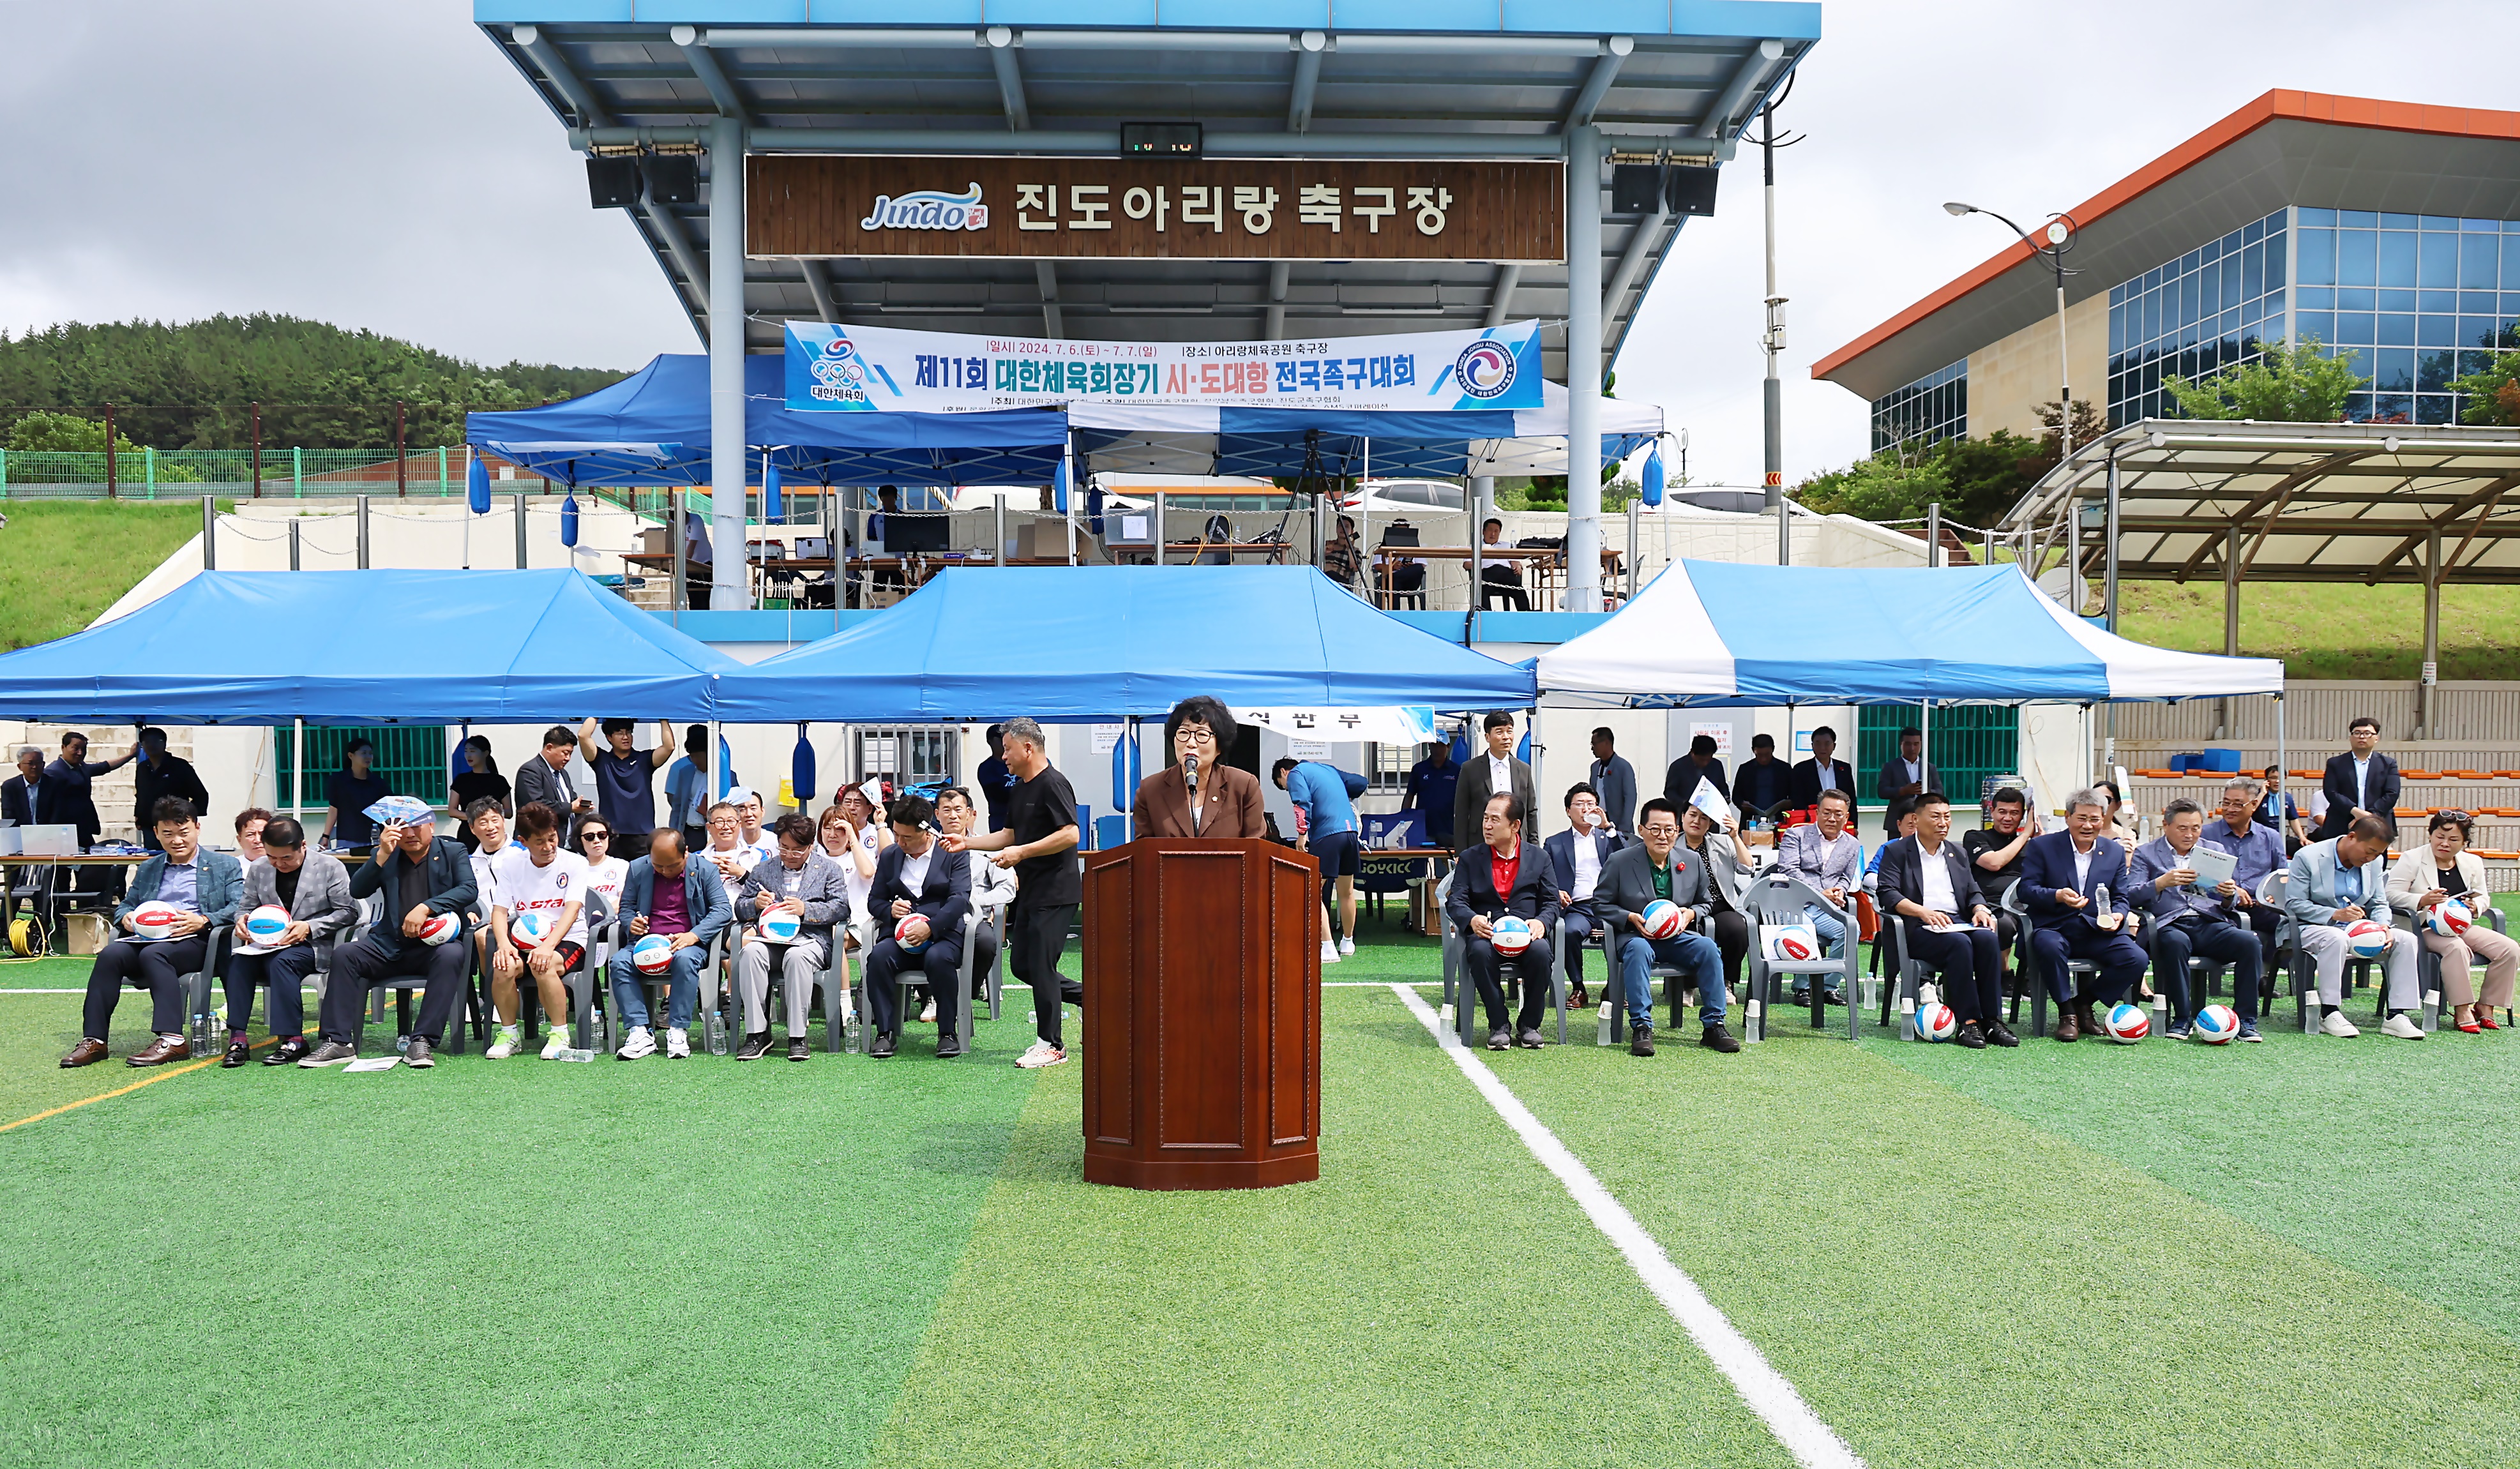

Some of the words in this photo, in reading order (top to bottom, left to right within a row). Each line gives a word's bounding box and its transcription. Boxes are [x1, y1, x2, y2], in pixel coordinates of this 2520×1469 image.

[864, 198, 965, 227] Jindo
[1016, 184, 1279, 235] 진도아리랑
[1299, 183, 1453, 236] 축구장
[1215, 343, 1292, 356] 아리랑체육공원
[1295, 342, 1329, 355] 축구장
[1484, 342, 1513, 365] ASSOCIATION
[915, 354, 988, 391] 제11회
[995, 358, 1158, 395] 대한체육회장기
[1275, 354, 1415, 393] 전국족구대회
[811, 386, 864, 401] 대한체육회
